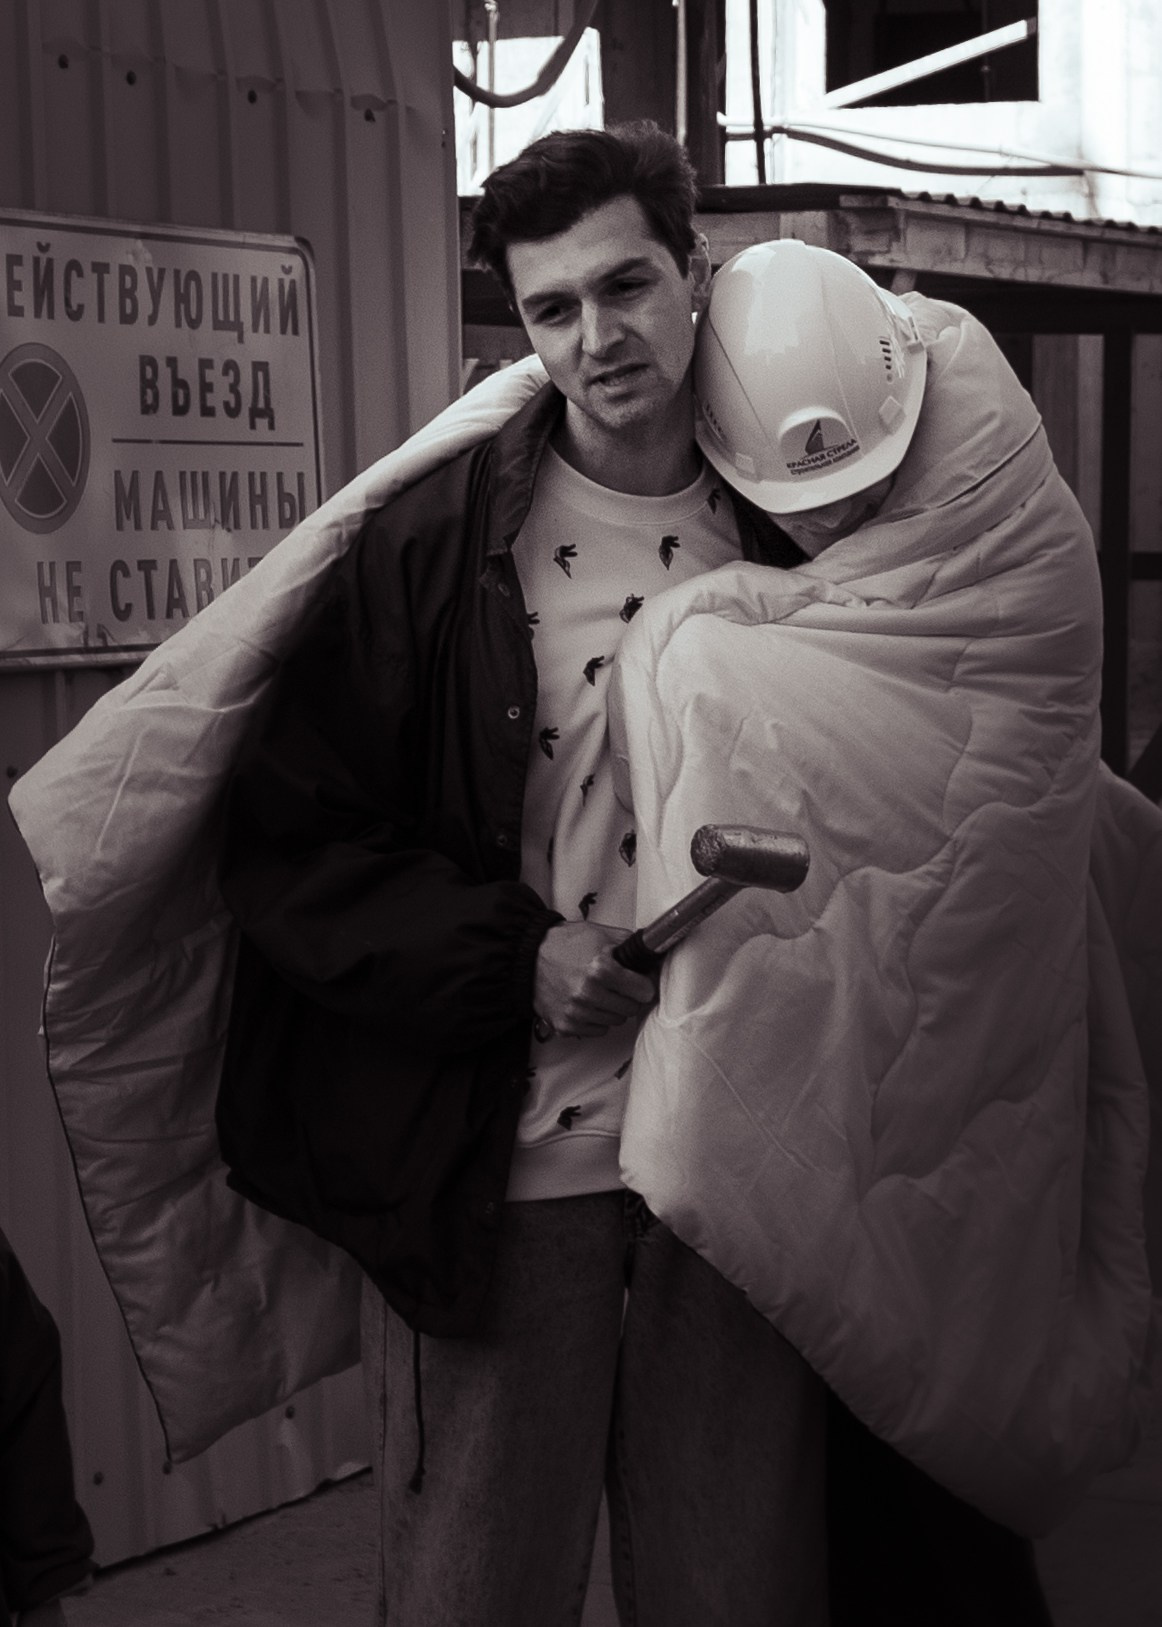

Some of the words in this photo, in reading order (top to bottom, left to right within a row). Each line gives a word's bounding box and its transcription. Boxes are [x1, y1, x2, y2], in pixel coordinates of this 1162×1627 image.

[6, 242, 300, 343] ЕЙСТВУЮЩИЙ
[138, 355, 276, 430] ВЪЕЗД
[787, 454, 826, 468] КРАСНАЯ
[827, 439, 857, 457] СТРЕЛА
[114, 469, 306, 532] МАШИНЫ
[37, 560, 84, 624] НЕ
